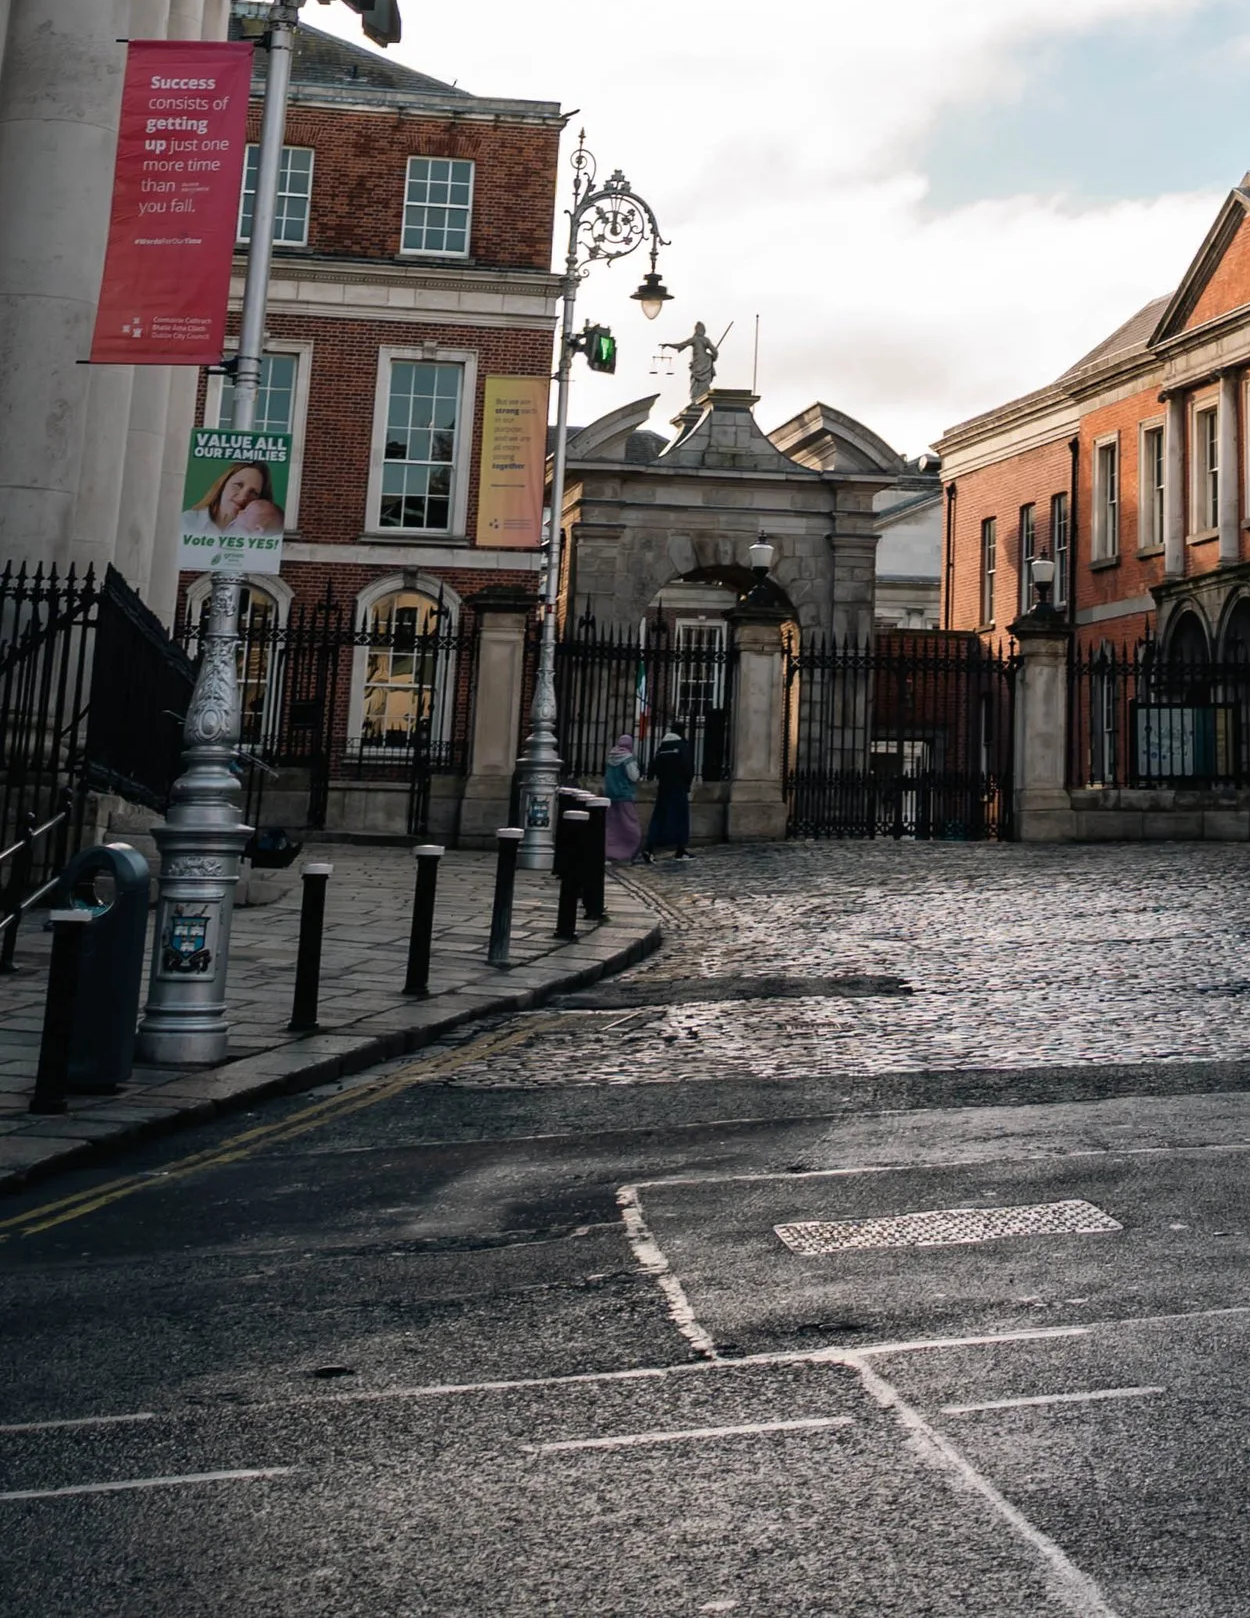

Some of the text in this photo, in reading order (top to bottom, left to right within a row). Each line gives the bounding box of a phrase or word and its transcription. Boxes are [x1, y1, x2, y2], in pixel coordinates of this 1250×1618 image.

[150, 75, 216, 90] Success
[148, 96, 230, 110] consists of
[145, 116, 208, 134] getting
[144, 137, 229, 154] up just one
[143, 157, 220, 171] more time
[141, 178, 176, 192] than
[138, 198, 196, 217] you fall.
[197, 433, 287, 451] VALUE ALL
[194, 446, 287, 461] OUR FAMILIES
[183, 534, 279, 550] Vote YES YES!
